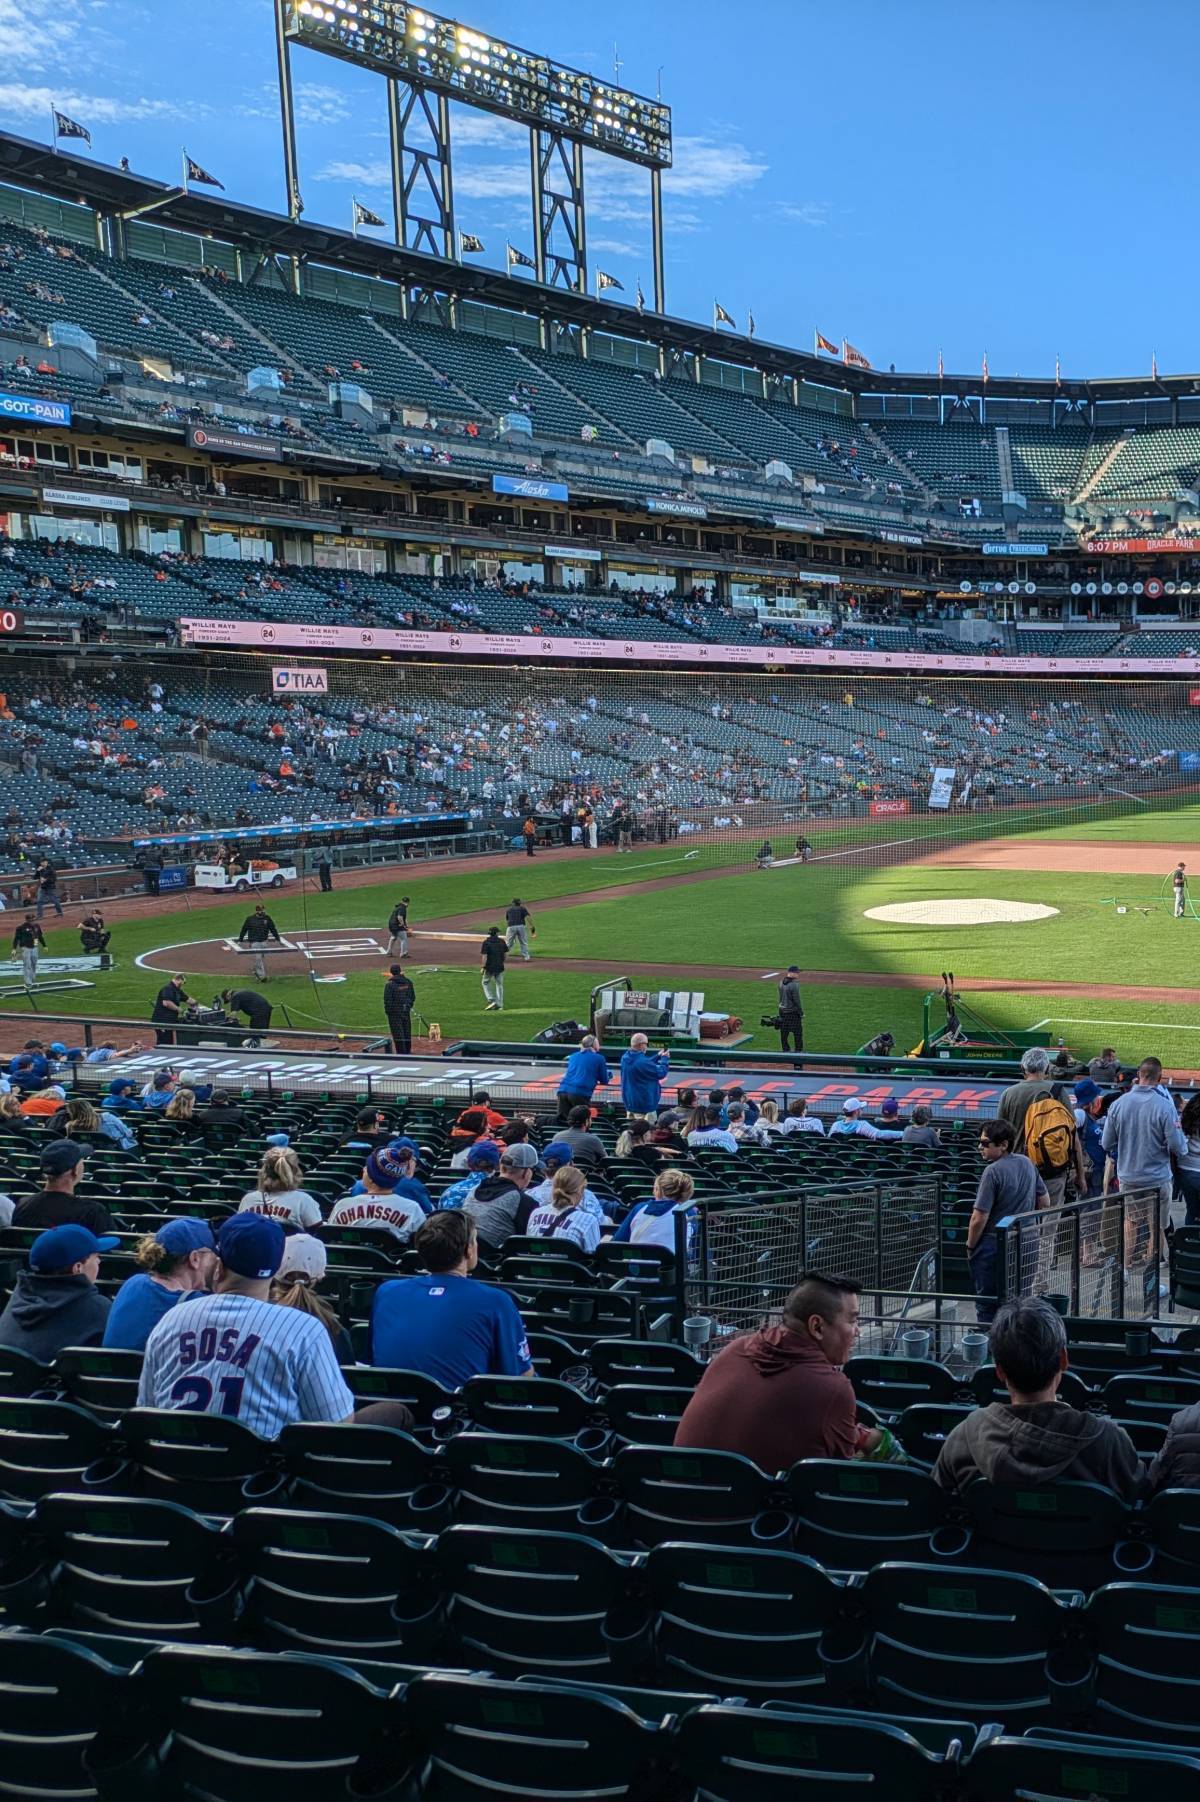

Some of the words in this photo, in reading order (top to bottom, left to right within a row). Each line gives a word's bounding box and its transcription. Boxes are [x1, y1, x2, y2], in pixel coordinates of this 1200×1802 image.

[513, 481, 549, 496] Alaska
[656, 501, 680, 512] KONICA
[680, 506, 706, 516] MINOLTA
[1087, 542, 1110, 552] 6:07
[1113, 542, 1128, 551] PM
[1147, 541, 1174, 550] ORACLE
[1175, 540, 1194, 549] PARK
[263, 630, 273, 638] 24
[450, 638, 459, 646] 24
[292, 673, 324, 688] TIAA
[876, 803, 905, 812] ORACLE
[416, 1069, 515, 1089] TO
[806, 1083, 997, 1111] PARK
[336, 1205, 410, 1228] JOHANSSON
[180, 1327, 262, 1369] SOSA
[171, 1375, 245, 1418] 21
